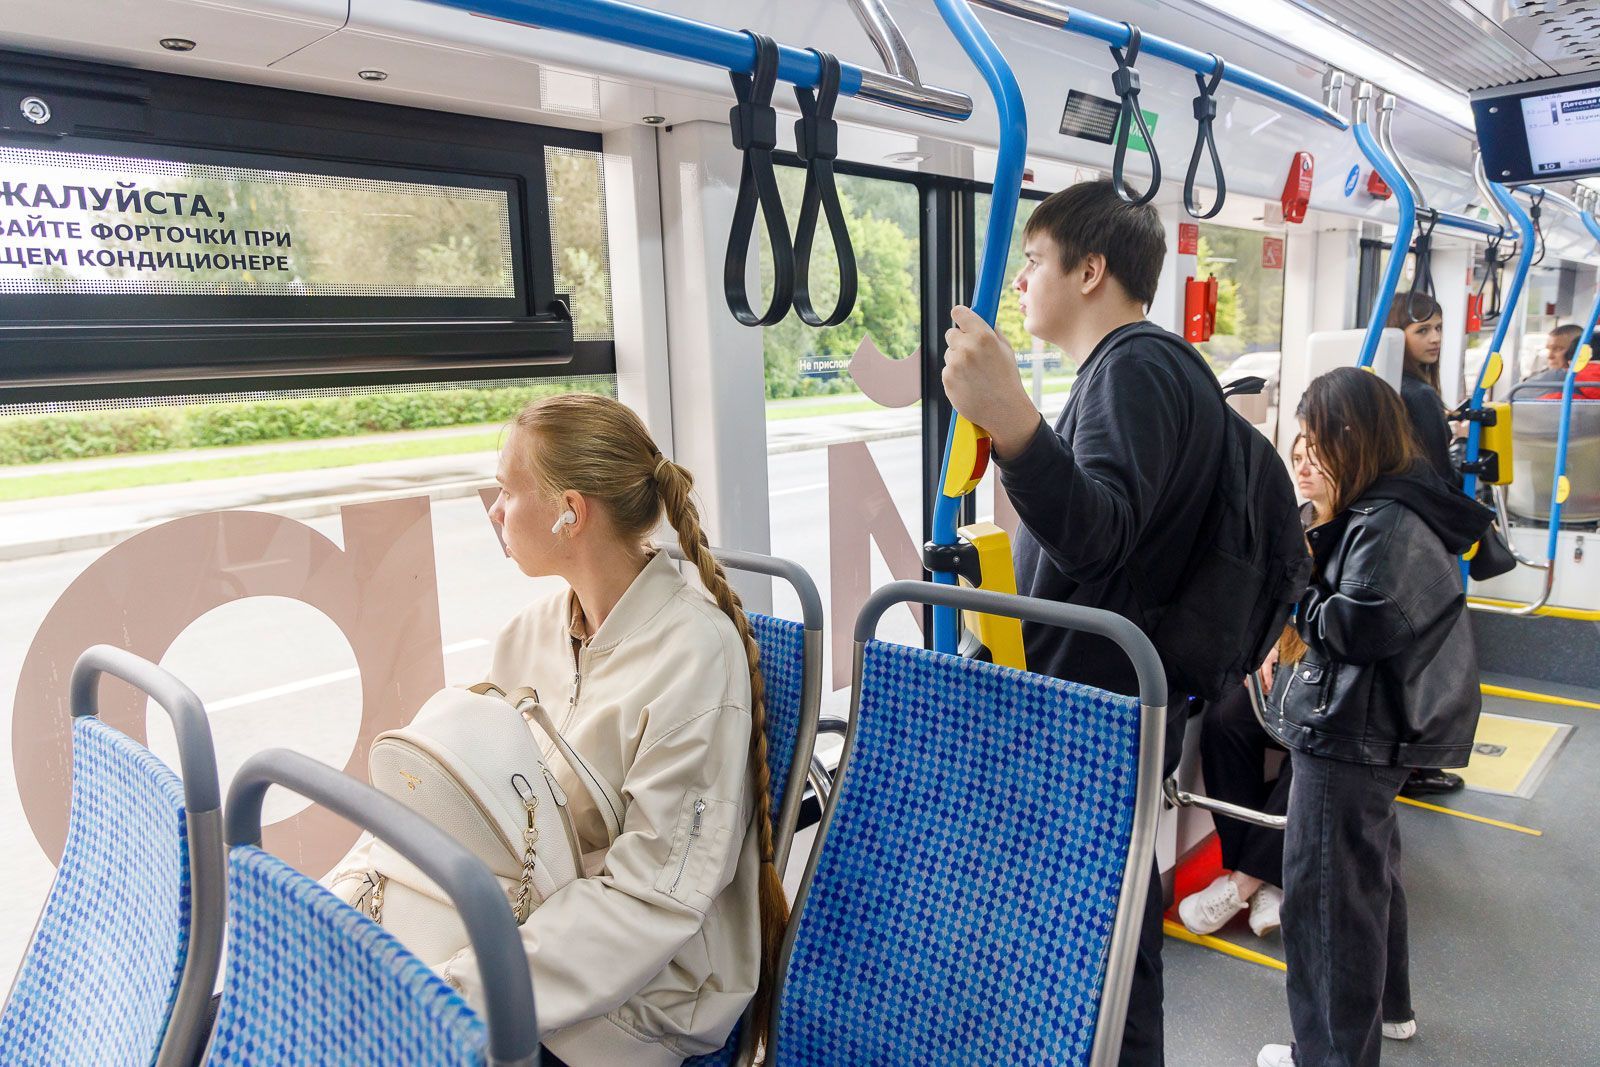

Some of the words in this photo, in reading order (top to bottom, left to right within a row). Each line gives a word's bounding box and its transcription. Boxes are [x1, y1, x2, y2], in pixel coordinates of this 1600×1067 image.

[91, 223, 236, 246] ФОРТОЧКИ
[245, 230, 292, 247] ПРИ
[79, 250, 289, 272] КОНДИЦИОНЕРЕ
[800, 360, 812, 371] Не
